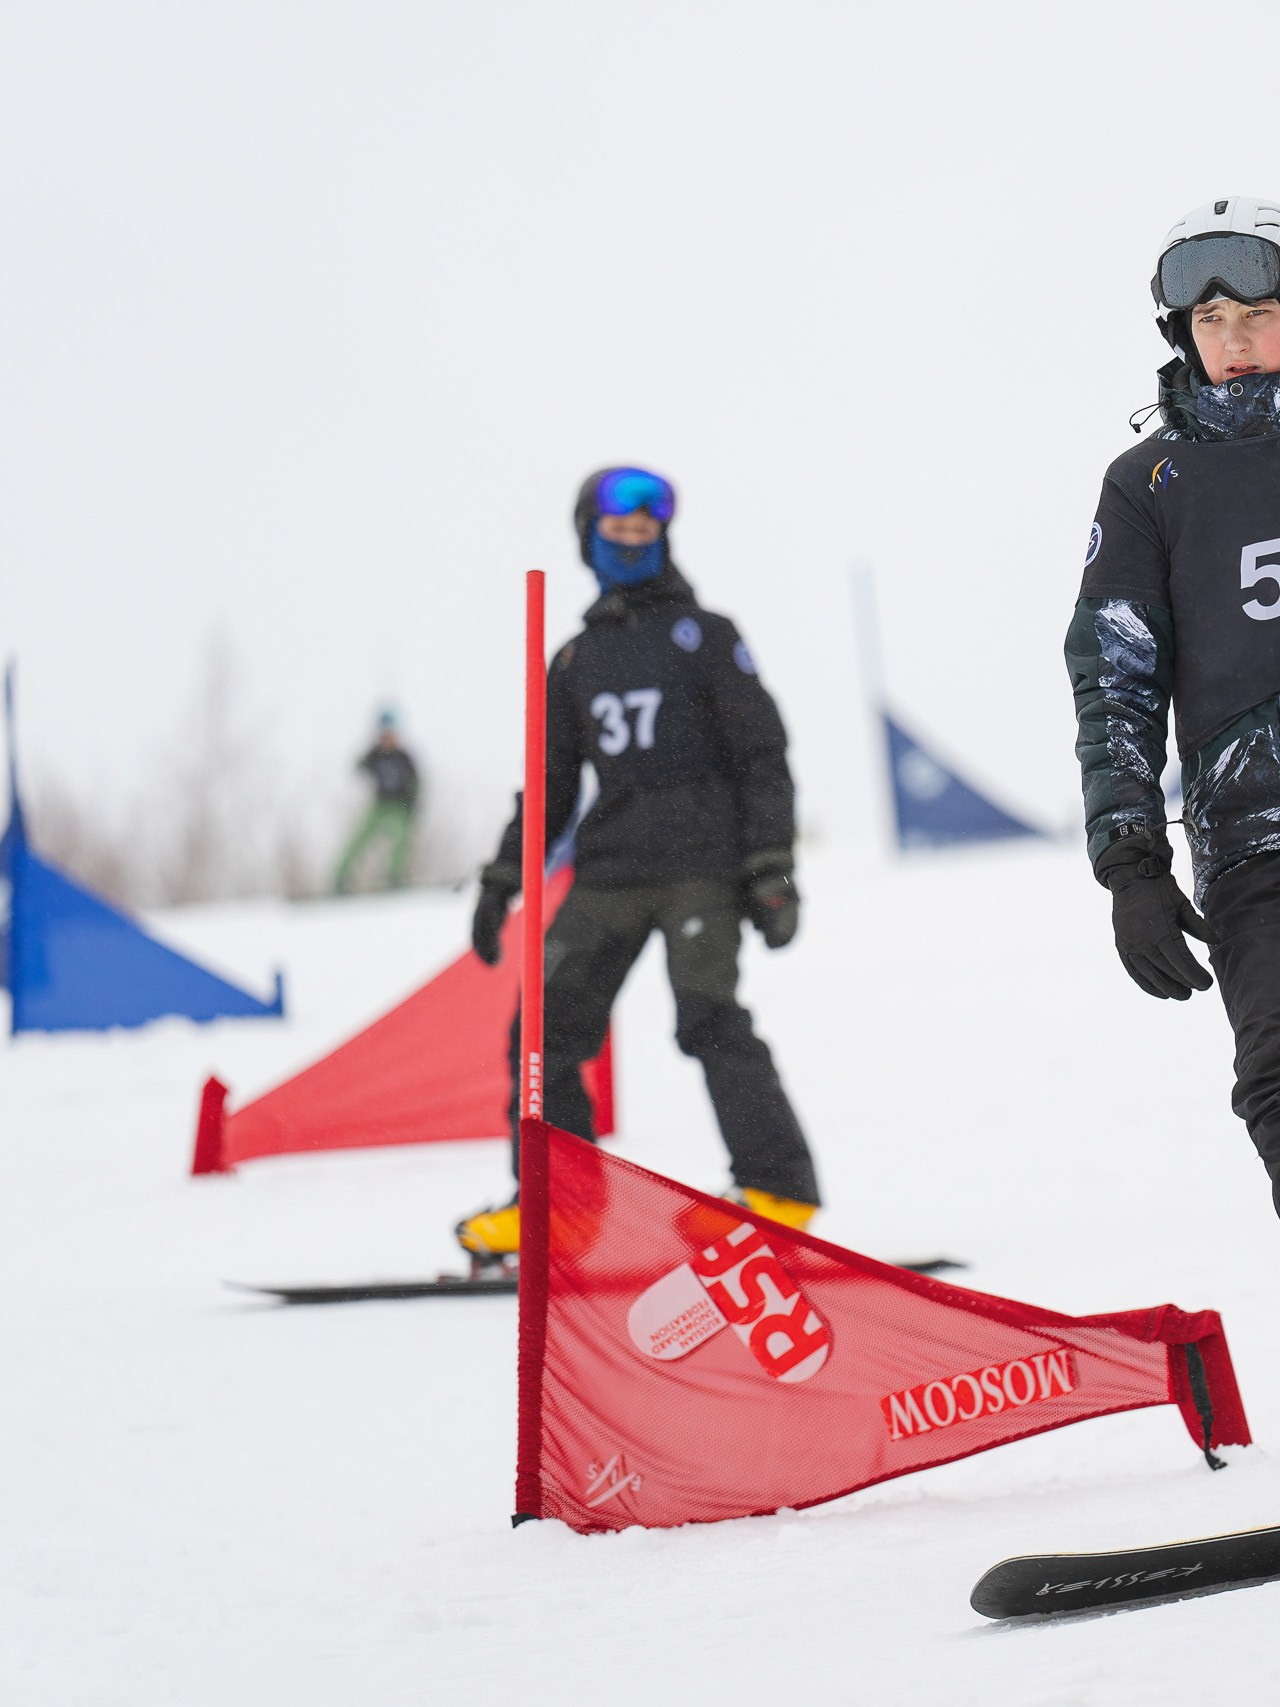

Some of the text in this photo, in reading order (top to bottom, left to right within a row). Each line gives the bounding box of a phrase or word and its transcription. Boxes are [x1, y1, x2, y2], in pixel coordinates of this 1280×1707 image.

[1148, 468, 1179, 493] FIS
[591, 688, 662, 756] 37
[529, 1052, 541, 1119] BREAK
[652, 1309, 715, 1354] SNOWBOARD
[889, 1349, 1075, 1440] MOSCOW
[1036, 1562, 1203, 1596] KESSLER
